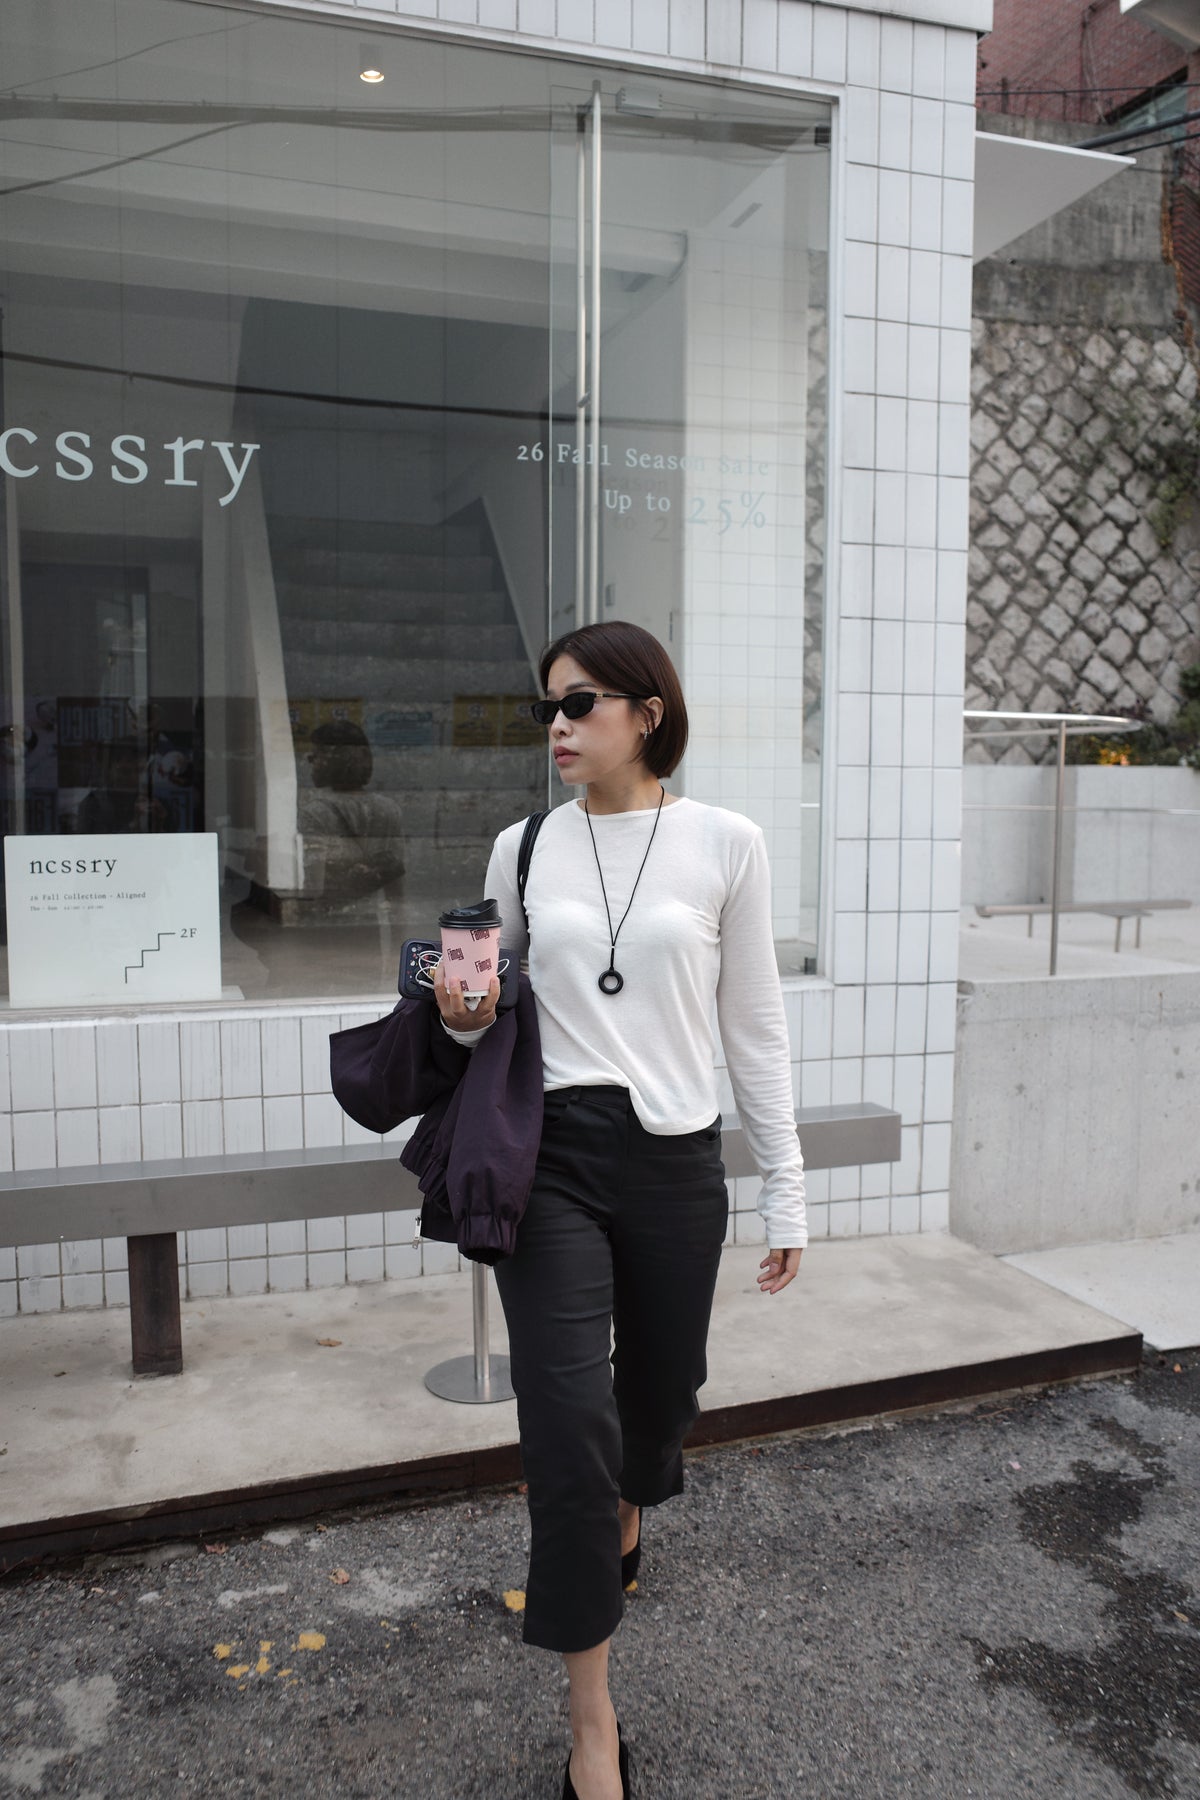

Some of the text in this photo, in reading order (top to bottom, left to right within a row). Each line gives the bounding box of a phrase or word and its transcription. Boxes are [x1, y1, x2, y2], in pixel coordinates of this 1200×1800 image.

[0, 427, 260, 507] cssry
[517, 442, 769, 476] 26 Fall Season Sale
[604, 489, 632, 514] Up
[645, 491, 671, 512] to
[687, 491, 767, 536] 25%
[29, 859, 117, 877] ncssry
[42, 893, 59, 901] Fall
[64, 892, 106, 901] Collection
[116, 891, 146, 900] Aligned
[180, 928, 197, 938] 2F
